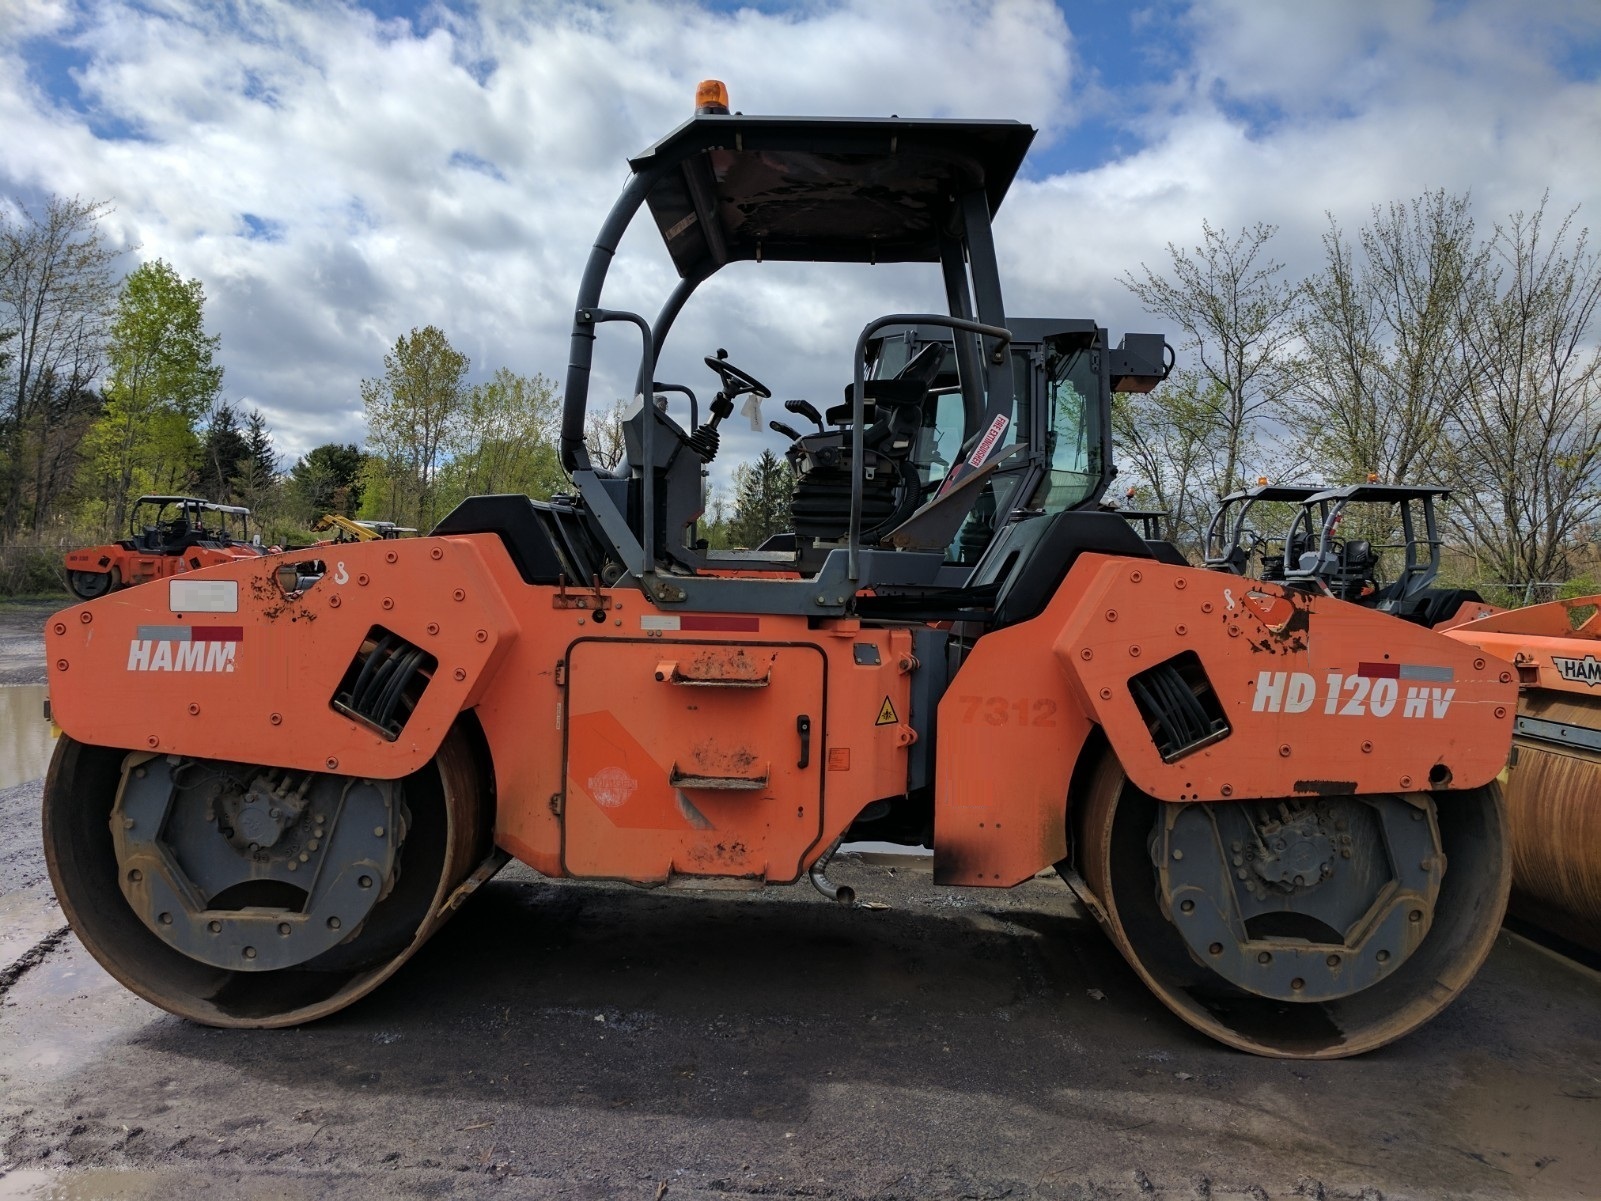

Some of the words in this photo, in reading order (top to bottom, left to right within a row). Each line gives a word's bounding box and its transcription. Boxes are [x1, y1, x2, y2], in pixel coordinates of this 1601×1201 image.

[993, 416, 1007, 431] FIRE
[970, 428, 999, 467] EXTINGUISHER
[126, 639, 237, 673] HAMM
[958, 696, 1058, 728] 7312
[1251, 671, 1317, 714] HD
[1323, 672, 1399, 718] 120
[1402, 686, 1457, 719] HV
